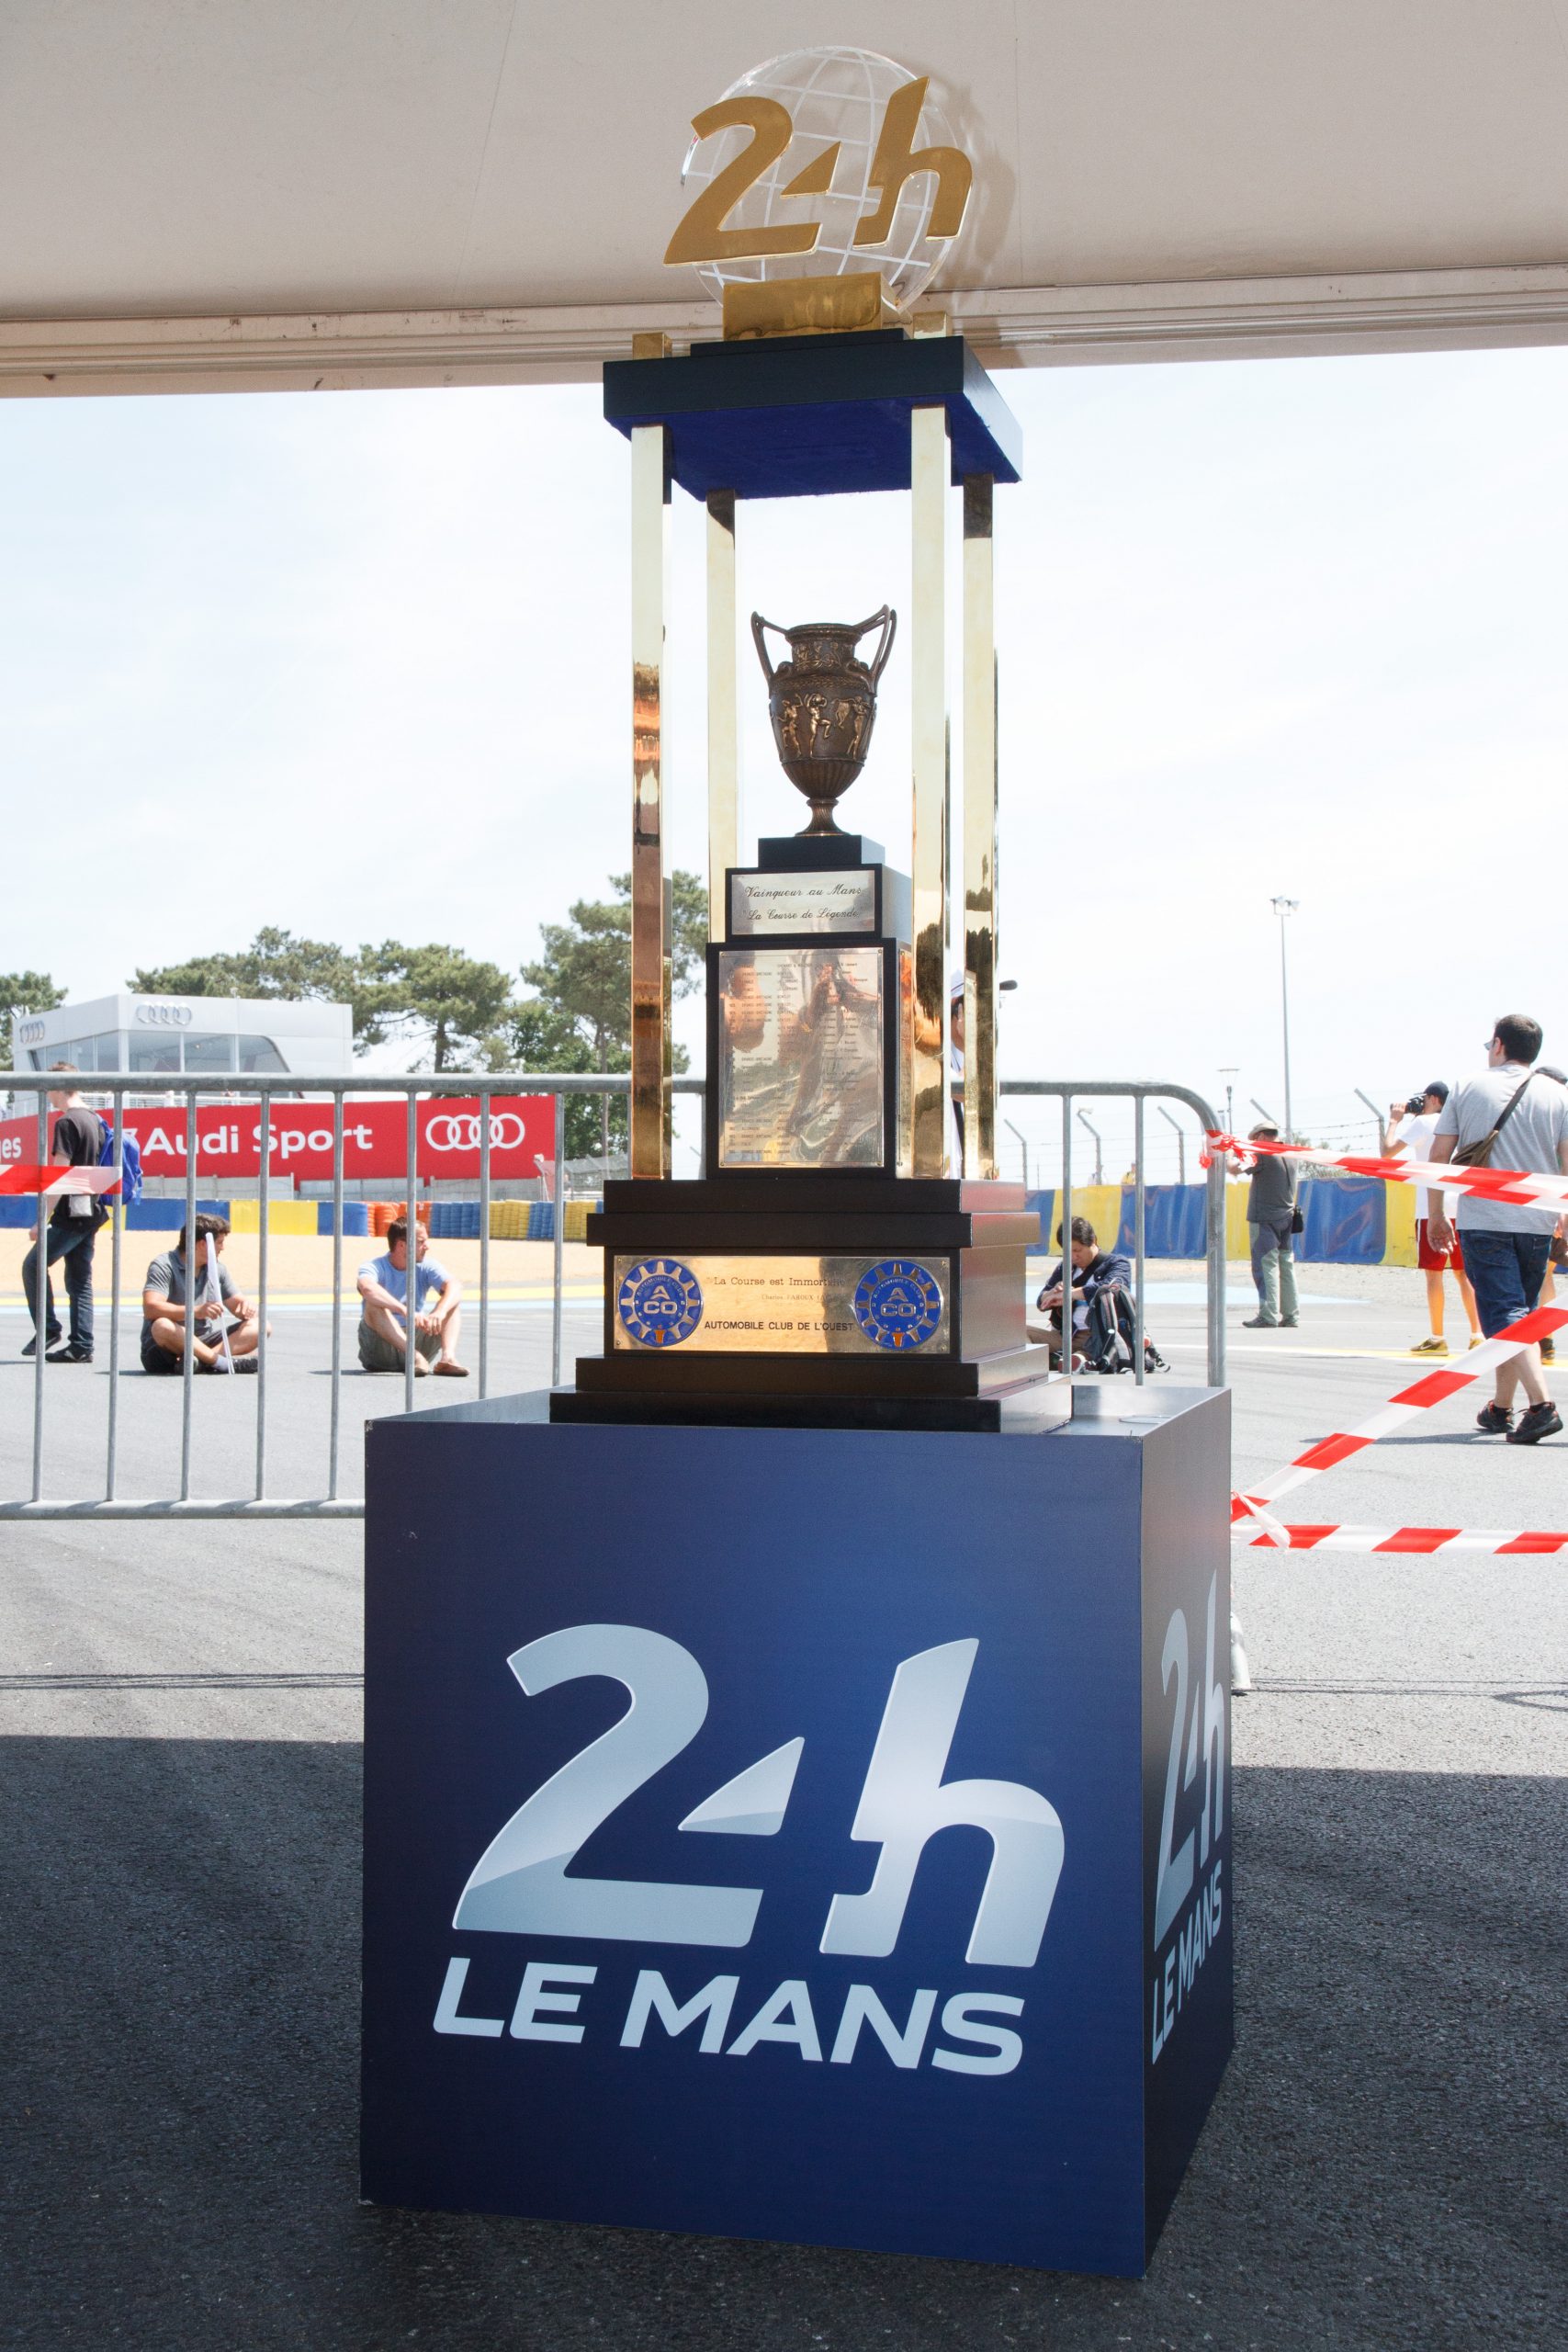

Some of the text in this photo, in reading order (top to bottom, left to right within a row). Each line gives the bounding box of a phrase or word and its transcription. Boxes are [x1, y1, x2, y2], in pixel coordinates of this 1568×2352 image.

[744, 883, 862, 899] Vainqueur au Mans
[801, 909, 813, 919] de
[0, 1136, 22, 1159] es
[141, 1125, 239, 1157] Audi
[730, 1276, 765, 1285] Course
[769, 1277, 784, 1285] est
[704, 1320, 854, 1332] AUTOMOBILE CLUB DE L'OUEST
[452, 1623, 1066, 1968] 24h
[1152, 1859, 1223, 2065] LE MANS
[433, 1956, 1025, 2076] LE MANS
